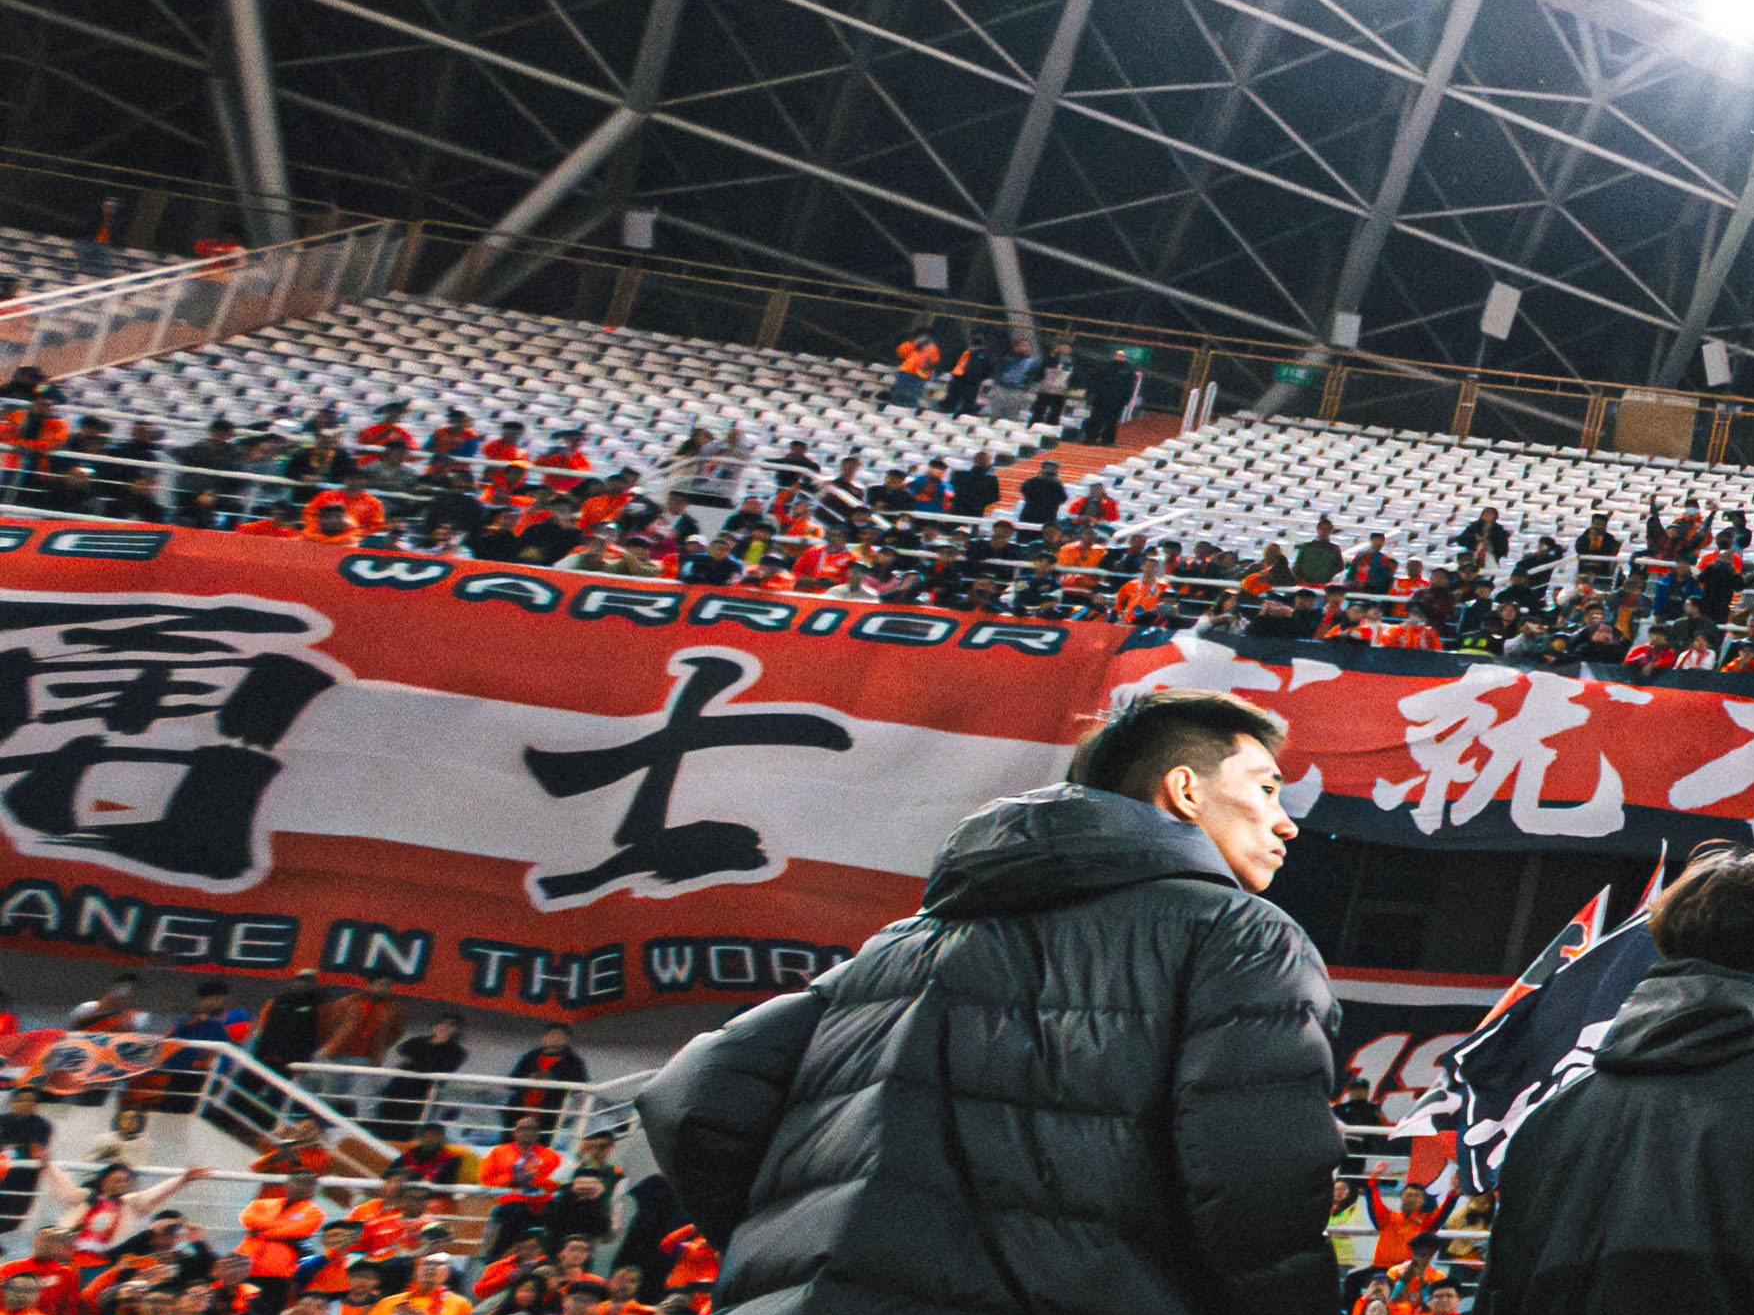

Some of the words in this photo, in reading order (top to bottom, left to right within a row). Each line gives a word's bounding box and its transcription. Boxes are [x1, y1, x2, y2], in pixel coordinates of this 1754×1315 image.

[341, 551, 1072, 655] WARRIOR
[328, 919, 430, 983] IN
[462, 938, 624, 1007] THE
[645, 938, 852, 993] WOR
